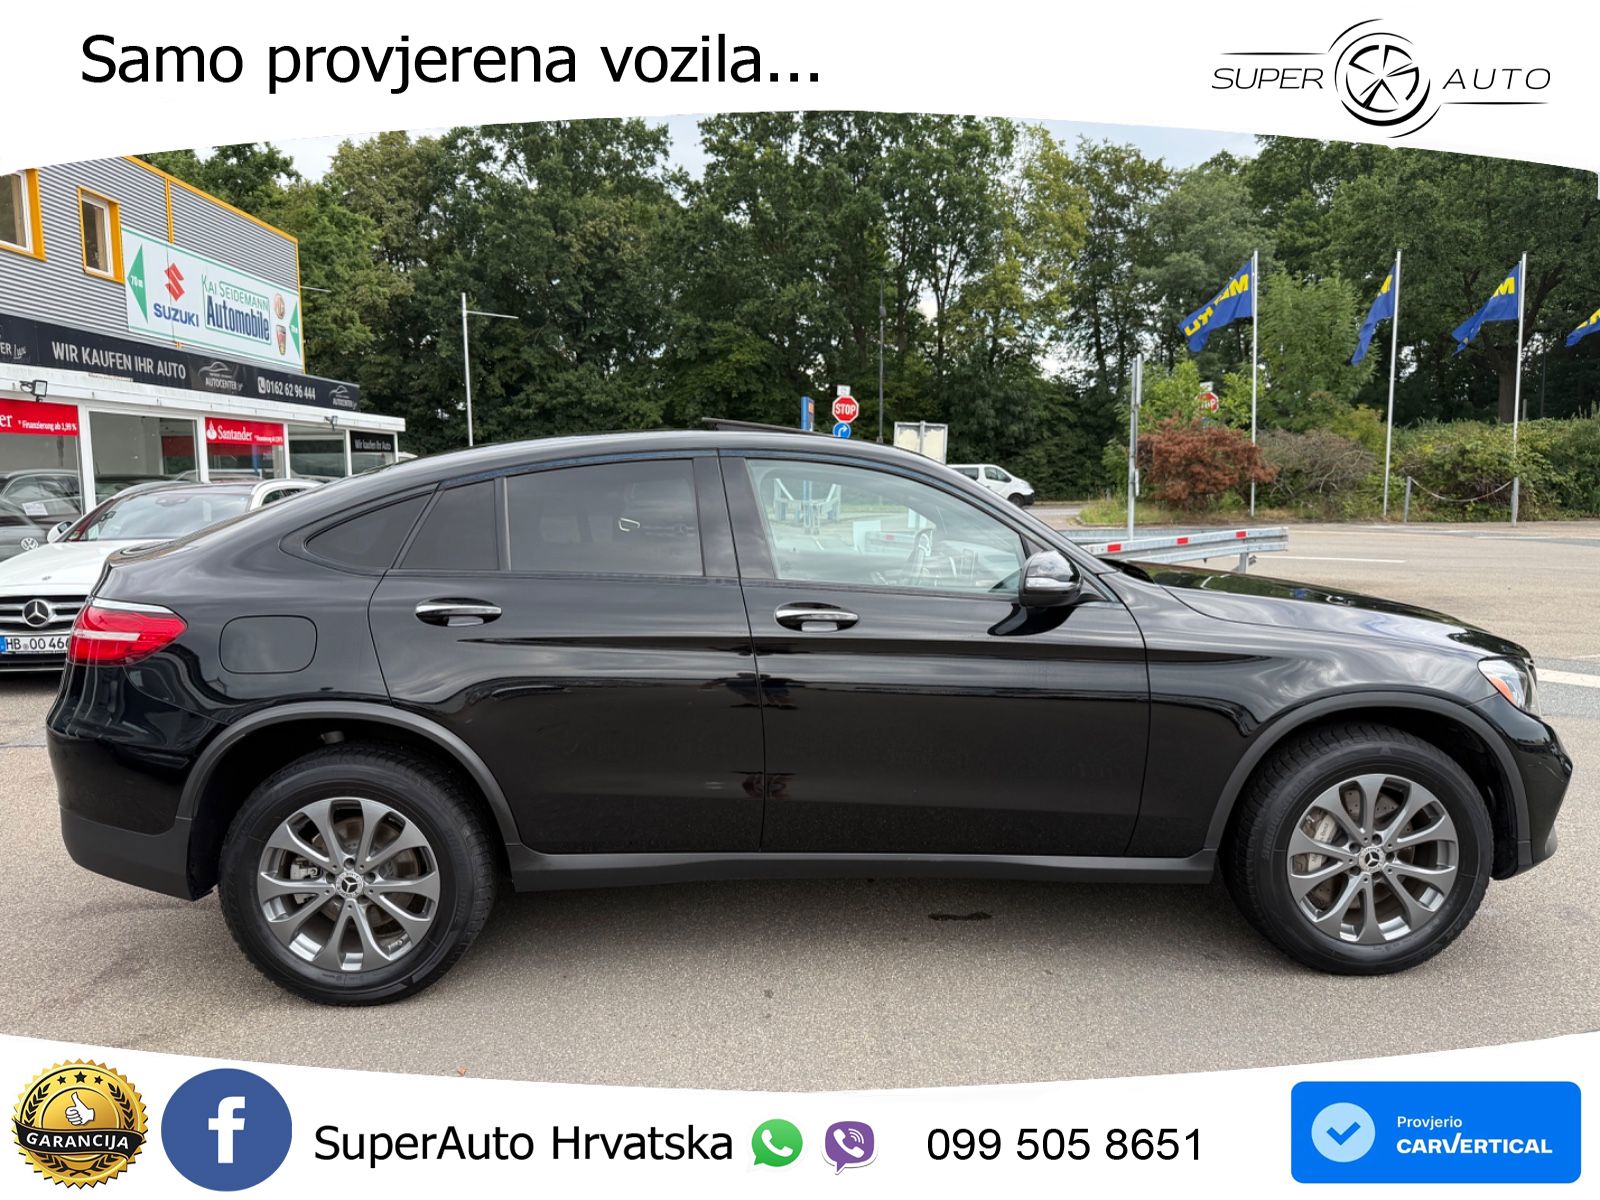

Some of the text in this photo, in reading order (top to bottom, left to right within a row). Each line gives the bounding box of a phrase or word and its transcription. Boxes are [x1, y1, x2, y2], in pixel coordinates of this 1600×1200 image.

[202, 274, 217, 295] KAI
[219, 281, 269, 311] SEIDEMANN
[153, 302, 199, 327] SUZUKI
[206, 295, 270, 341] Automobile
[0, 342, 12, 356] ER
[51, 341, 79, 363] WIR
[82, 347, 132, 371] KAUFEN
[134, 356, 154, 374] IHR
[157, 361, 186, 380] AUTO
[266, 379, 316, 400] 0162 62 96 444
[835, 403, 856, 415] STOP
[217, 425, 252, 441] Santander
[6, 638, 21, 650] HB
